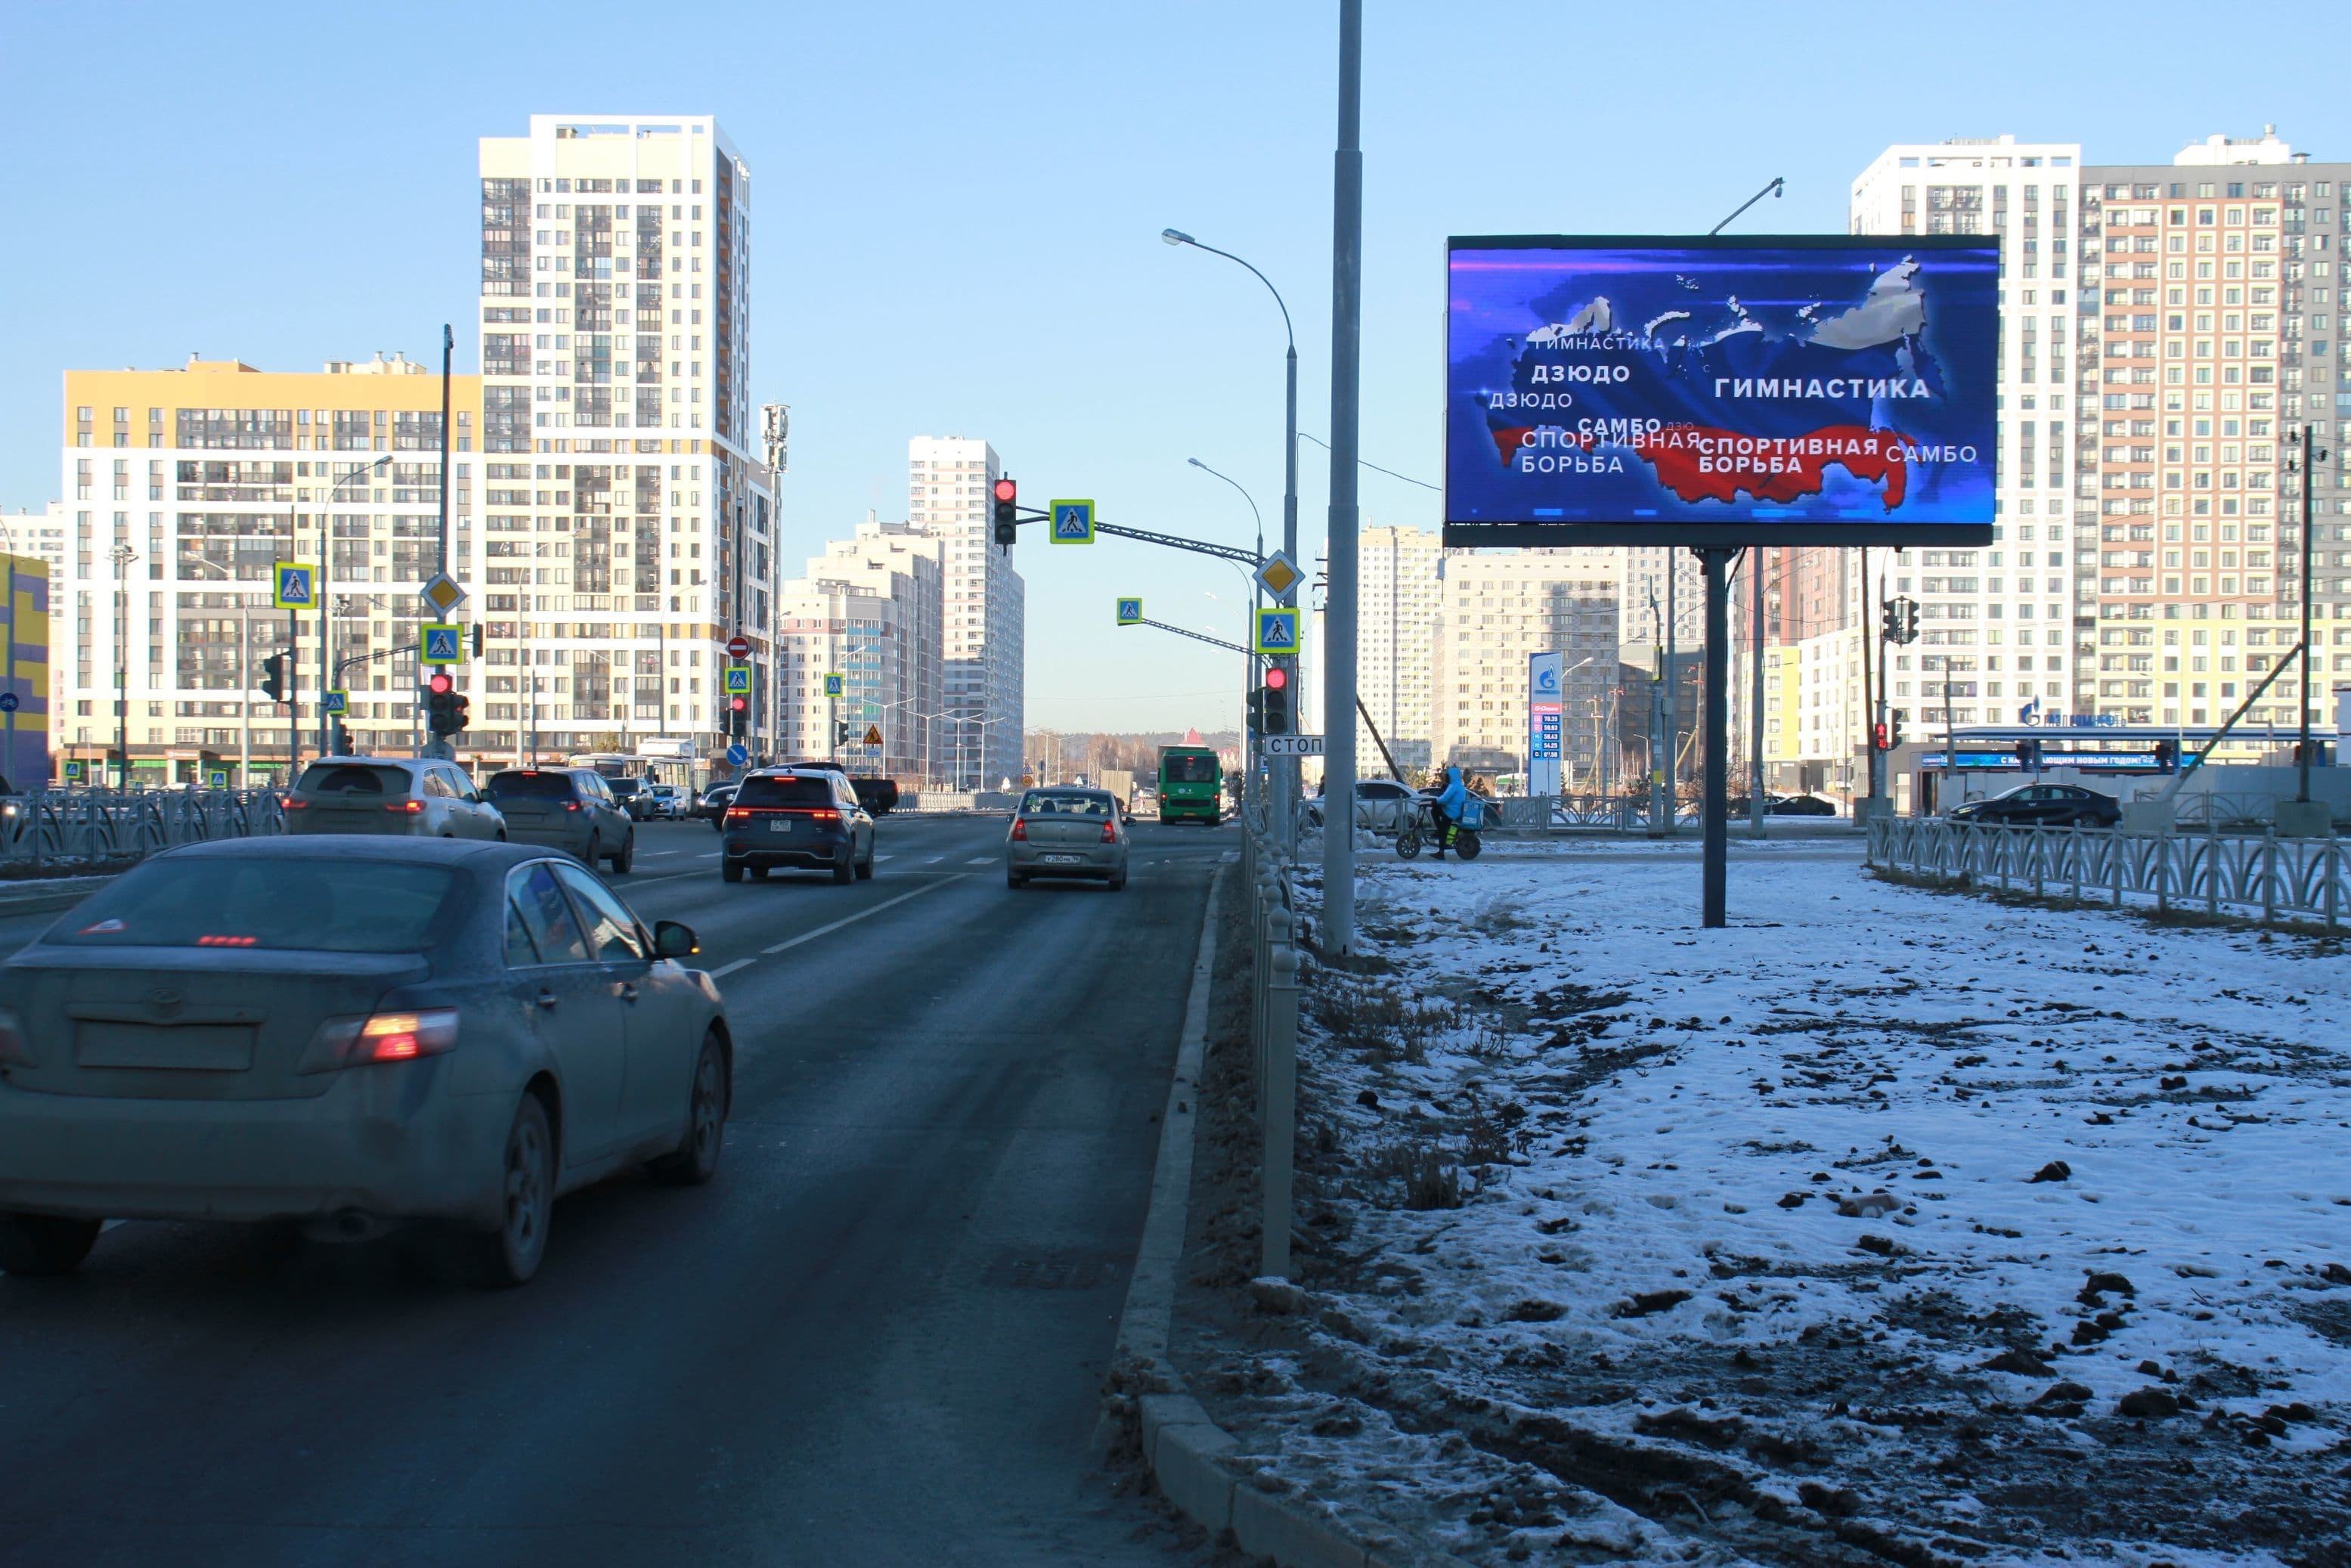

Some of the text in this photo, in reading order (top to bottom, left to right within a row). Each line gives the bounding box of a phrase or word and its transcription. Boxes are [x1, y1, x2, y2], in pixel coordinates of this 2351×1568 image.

[1535, 337, 1665, 350] ГИМНАСТИКА
[1532, 364, 1631, 384] ДЗЮДО
[1714, 378, 1929, 398] ГИМНАСТИКА
[1489, 392, 1572, 409] ДЗЮДО
[1578, 418, 1661, 434] САМБО
[1522, 431, 1700, 448] СПОРТИВНАЯ
[1699, 438, 1878, 455] СПОРТИВНАЯ
[1885, 445, 1977, 463] САМБО
[1522, 456, 1624, 473] БОРЬБА
[1699, 456, 1803, 473] БОРЬБА
[1272, 739, 1321, 752] СТОП
[2110, 757, 2141, 765] ГОДОМ!
